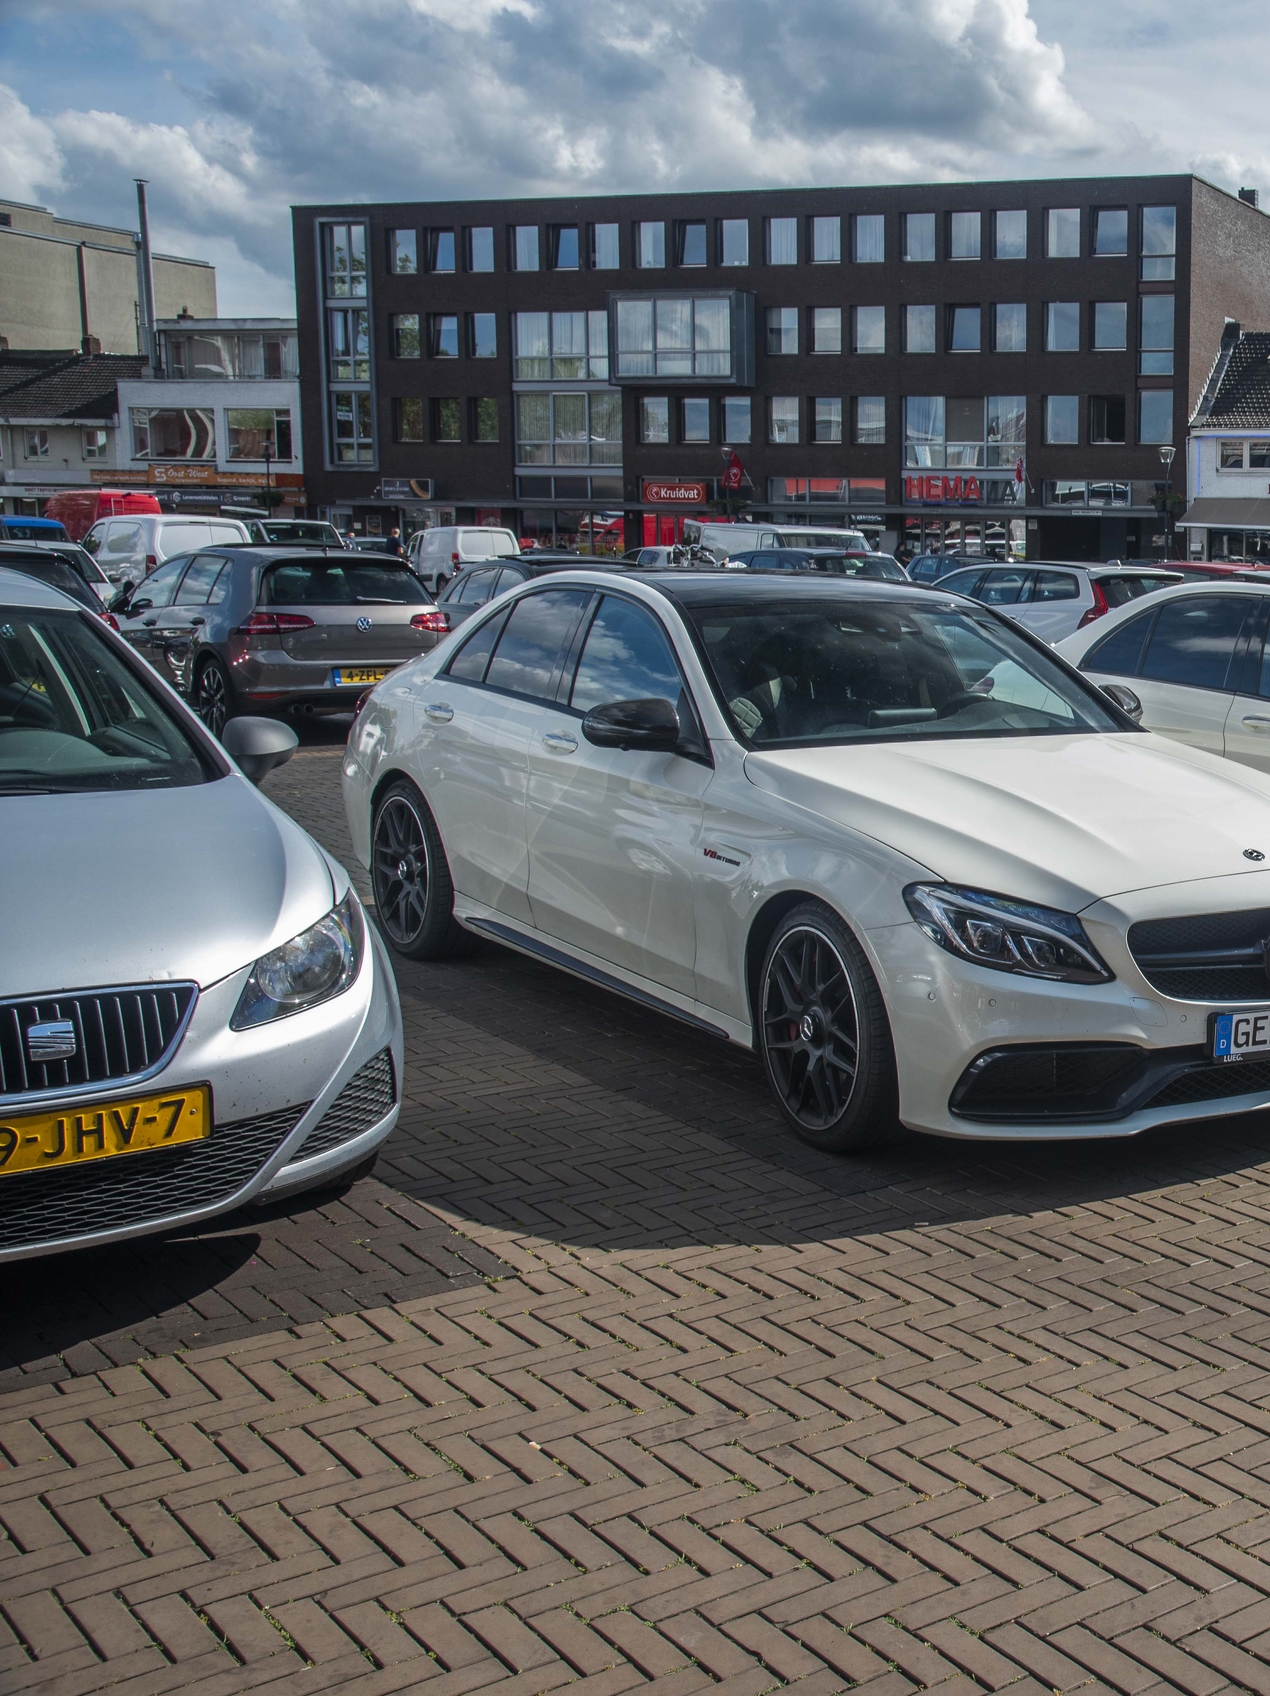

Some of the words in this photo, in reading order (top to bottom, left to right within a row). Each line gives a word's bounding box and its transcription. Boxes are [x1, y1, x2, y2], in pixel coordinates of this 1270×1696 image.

[905, 475, 982, 499] HEMA
[661, 488, 699, 499] Kruidvat
[1219, 1039, 1227, 1049] D
